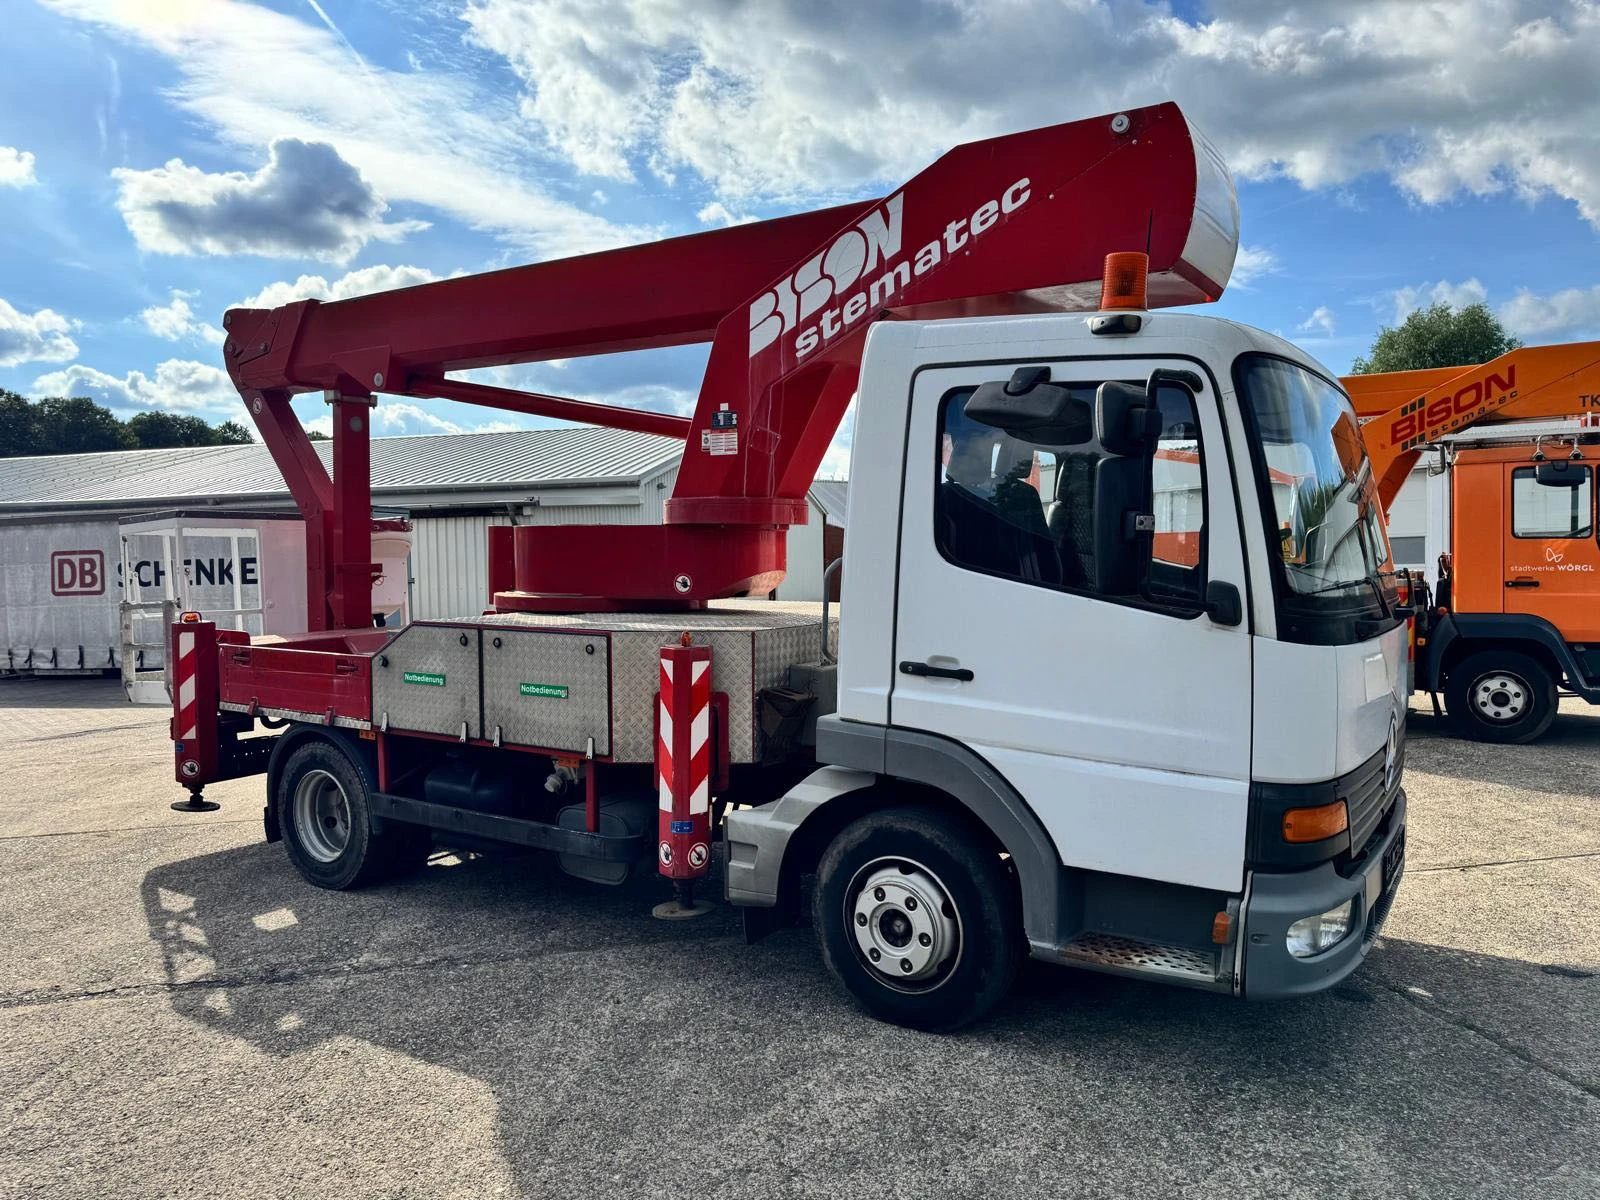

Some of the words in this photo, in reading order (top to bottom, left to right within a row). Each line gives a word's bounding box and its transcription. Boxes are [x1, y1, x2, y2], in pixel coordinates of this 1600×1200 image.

[749, 191, 905, 358] BISON
[795, 177, 1031, 358] stematec
[1391, 364, 1516, 446] BISON
[57, 557, 98, 589] DB
[1510, 564, 1555, 572] stadtwerke
[1557, 563, 1595, 572] WÖRGL
[404, 673, 444, 686] Notbedienung
[520, 684, 566, 698] Notbedienung
